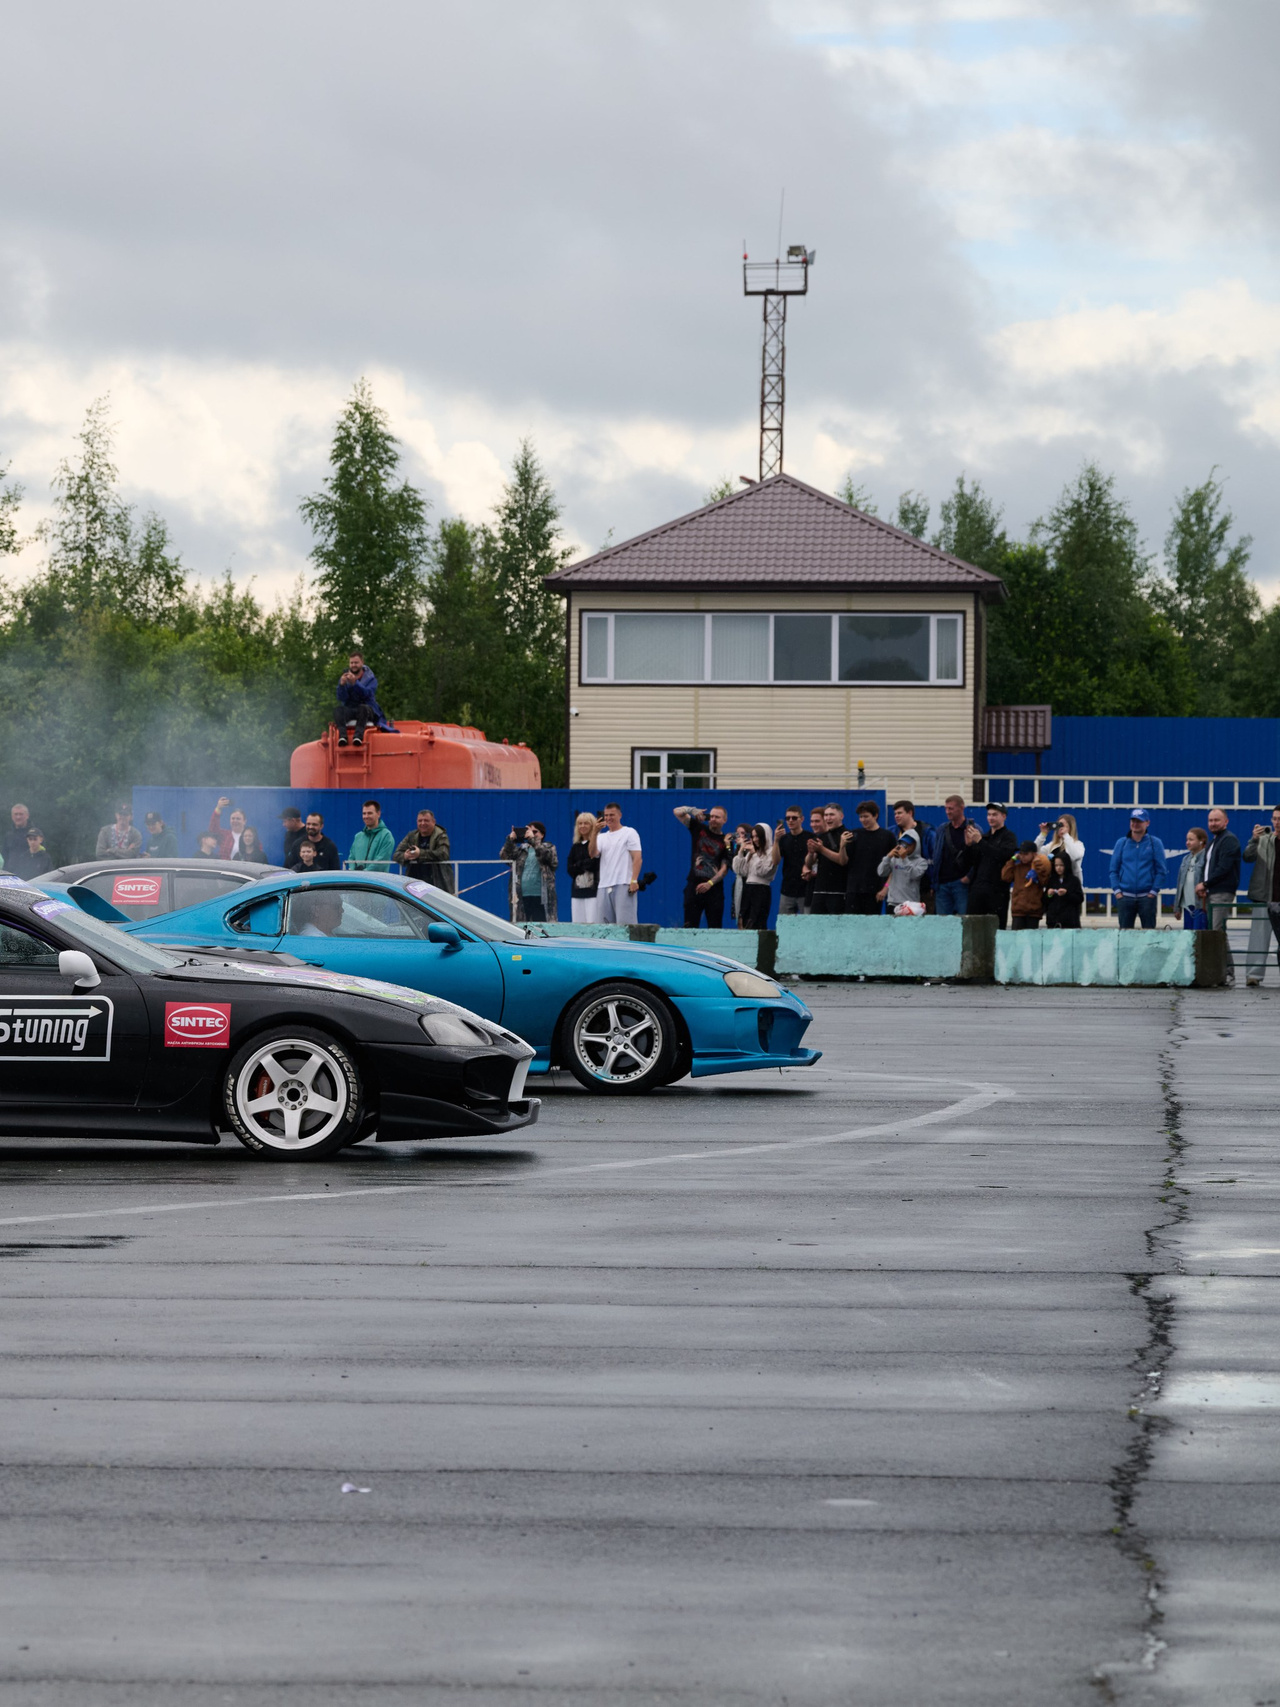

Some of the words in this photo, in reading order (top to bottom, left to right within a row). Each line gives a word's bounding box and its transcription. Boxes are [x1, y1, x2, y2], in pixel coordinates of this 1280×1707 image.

[171, 1017, 224, 1028] SINTEC
[225, 1074, 264, 1151] MICHELIN
[328, 1044, 358, 1123] MICHELIN
